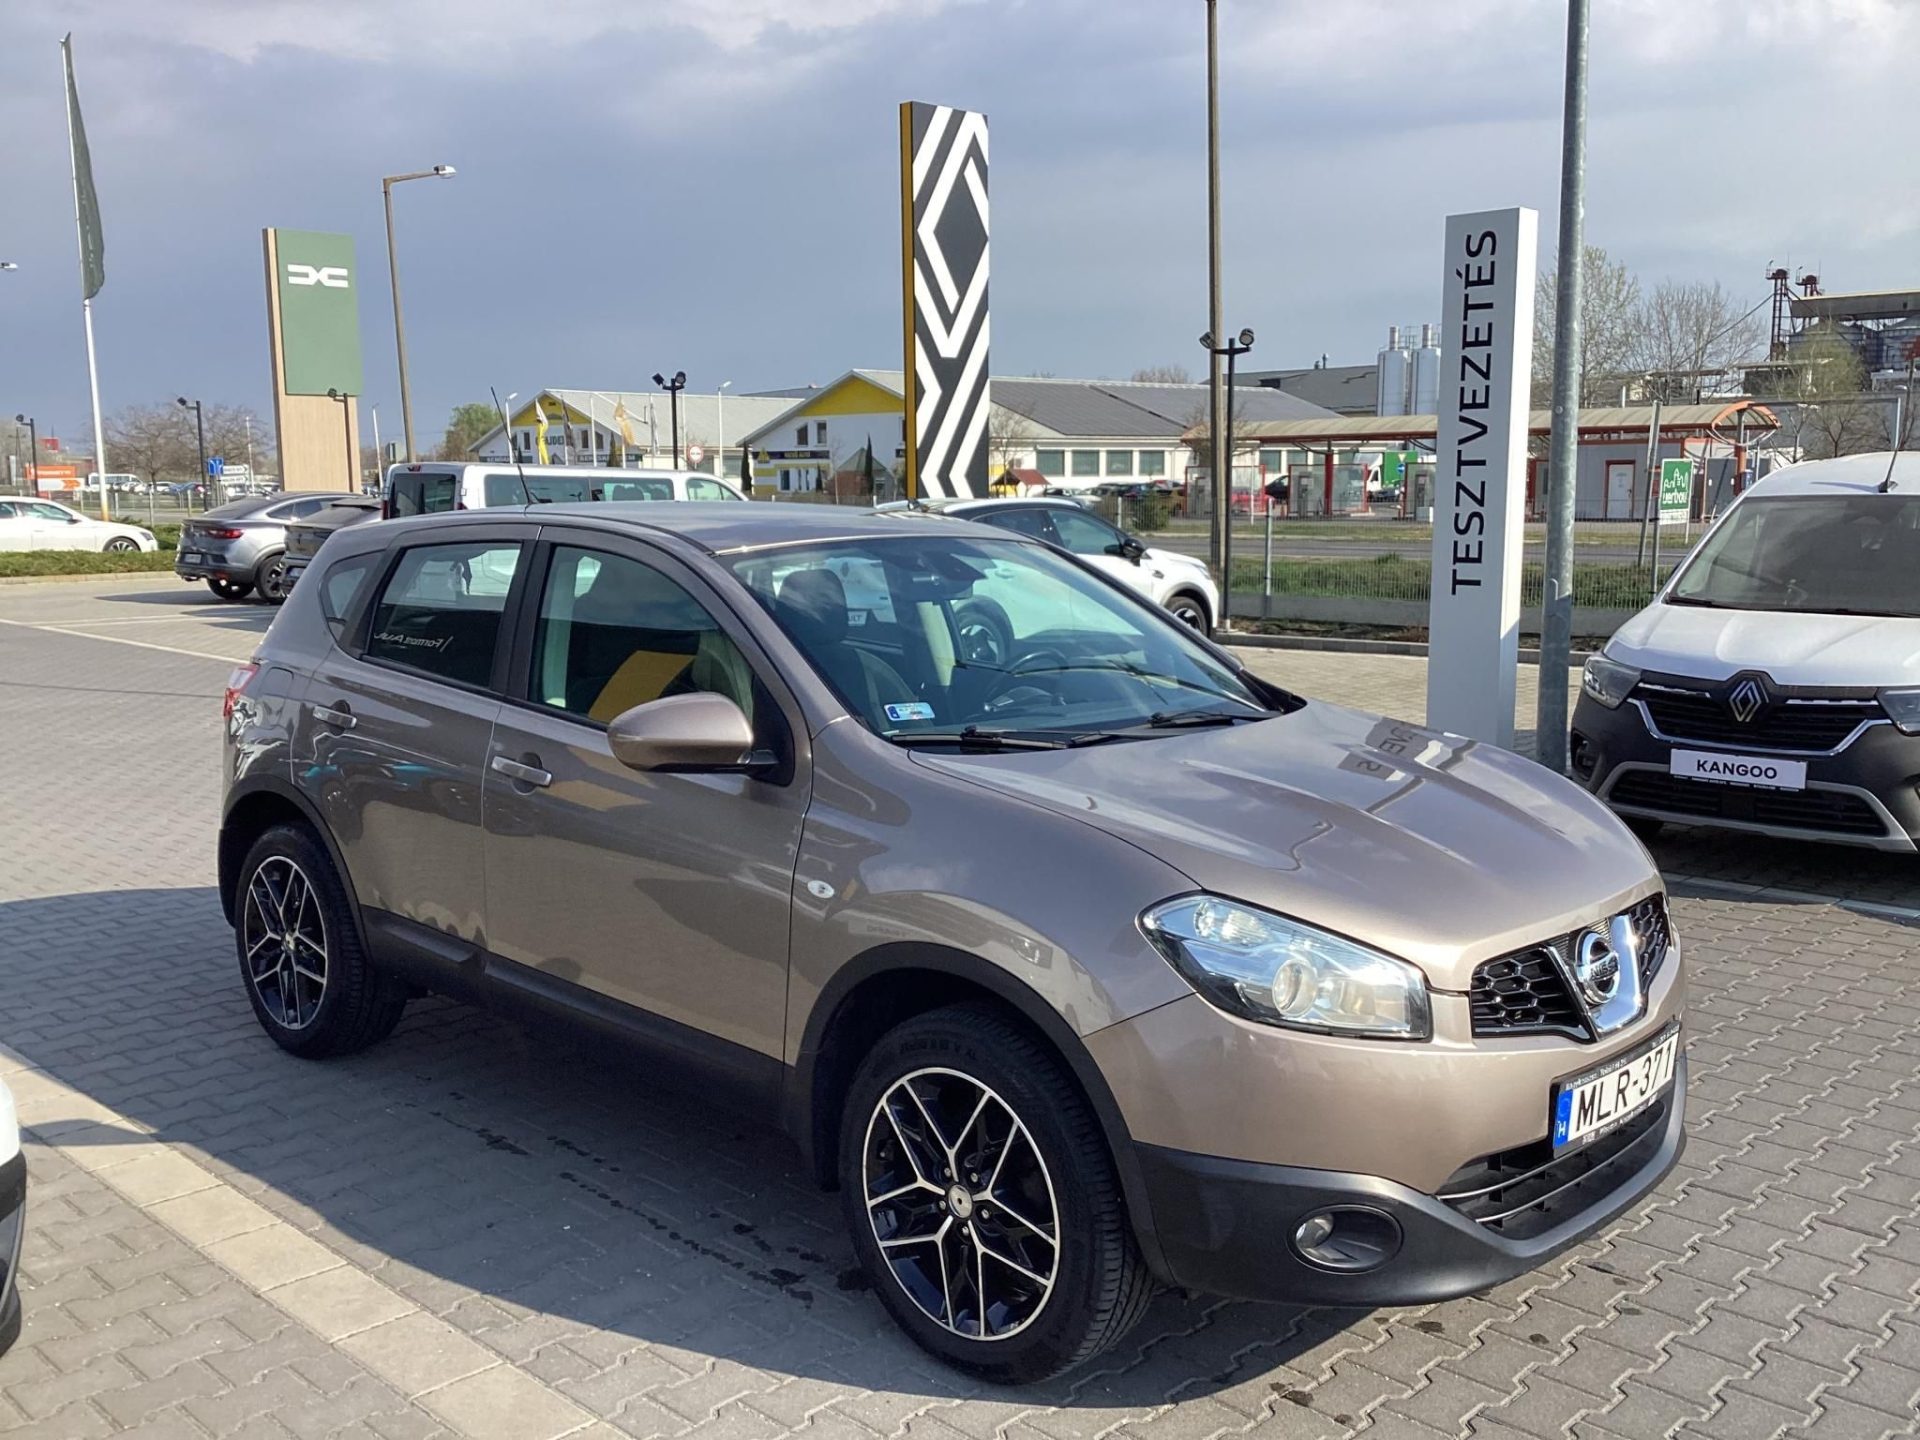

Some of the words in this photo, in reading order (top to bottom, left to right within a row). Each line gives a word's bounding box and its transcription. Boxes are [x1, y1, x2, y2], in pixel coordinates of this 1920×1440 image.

[1451, 230, 1497, 595] TESZTVEZETÉS
[1696, 759, 1777, 779] KANGOO
[1576, 1040, 1673, 1132] MLR-371
[1557, 1121, 1567, 1138] H
